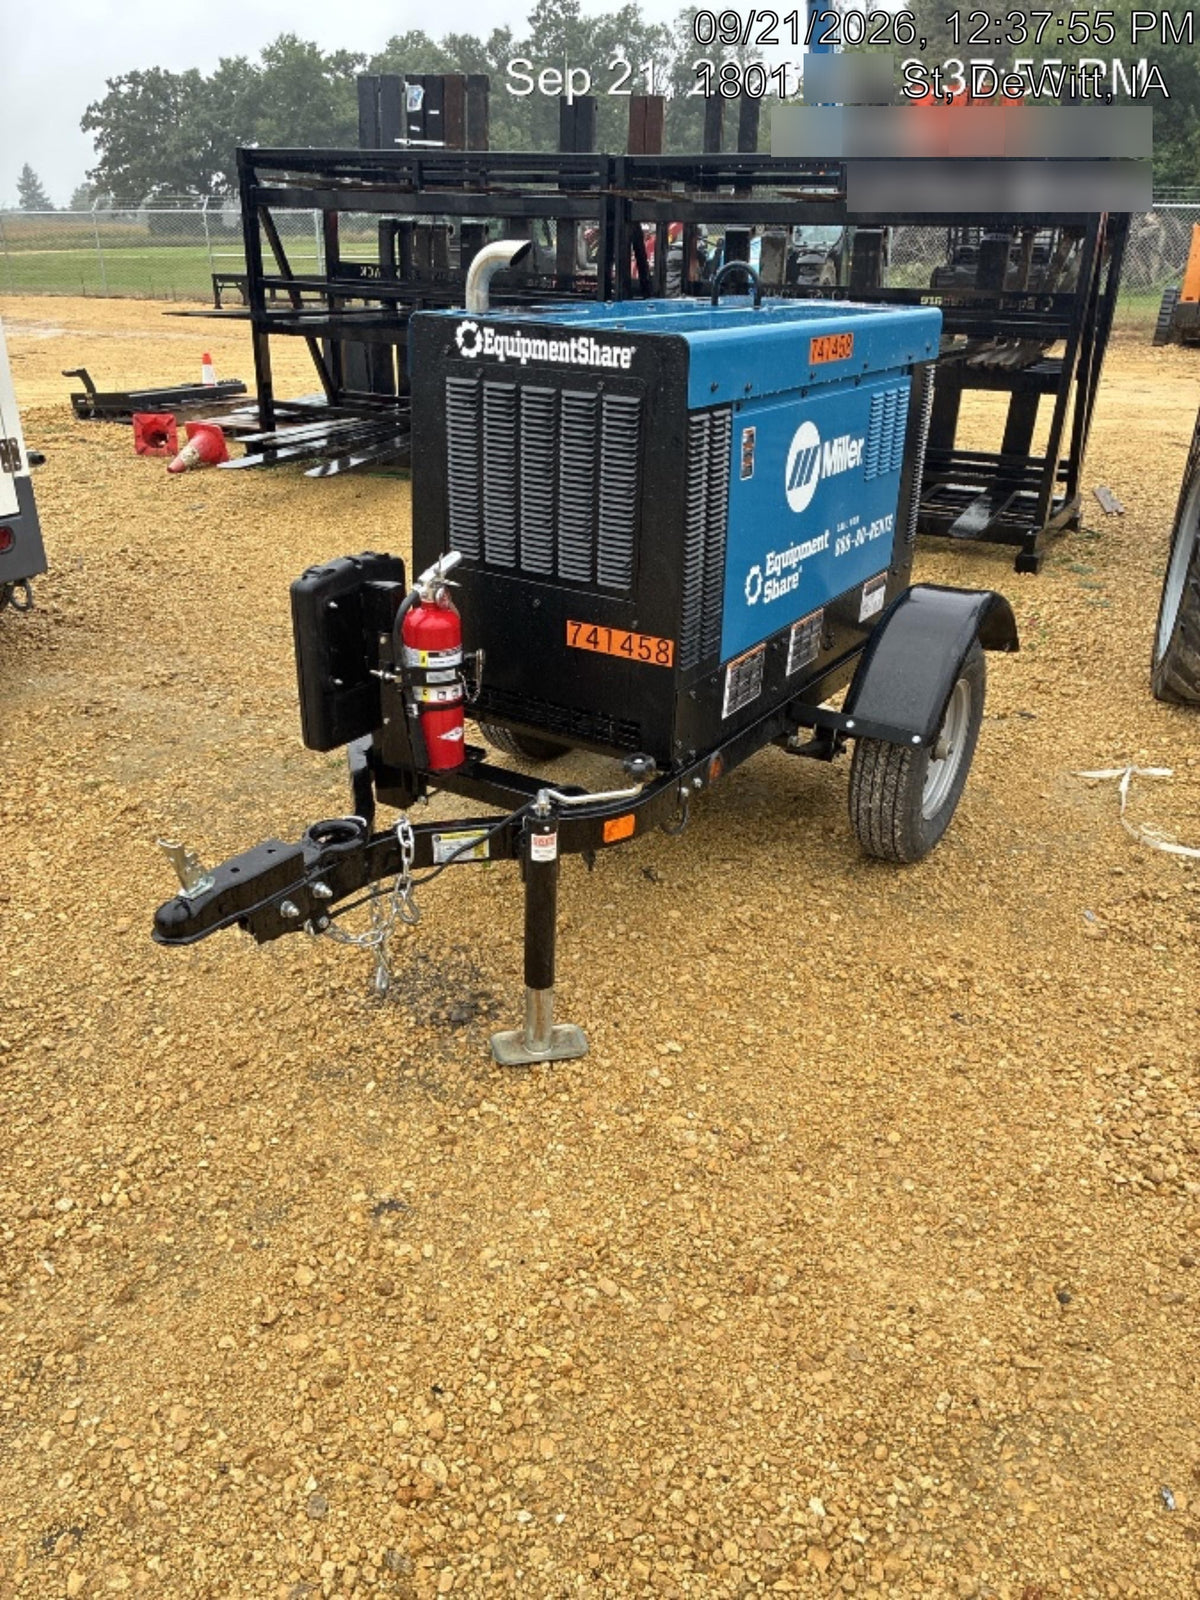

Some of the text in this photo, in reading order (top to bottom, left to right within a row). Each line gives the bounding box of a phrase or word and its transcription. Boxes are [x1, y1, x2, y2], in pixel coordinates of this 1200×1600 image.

[482, 326, 632, 369] EquipmentShare
[821, 435, 865, 479] Miller
[765, 529, 830, 576] Equipment
[763, 572, 800, 604] Share
[570, 622, 670, 664] 741458
